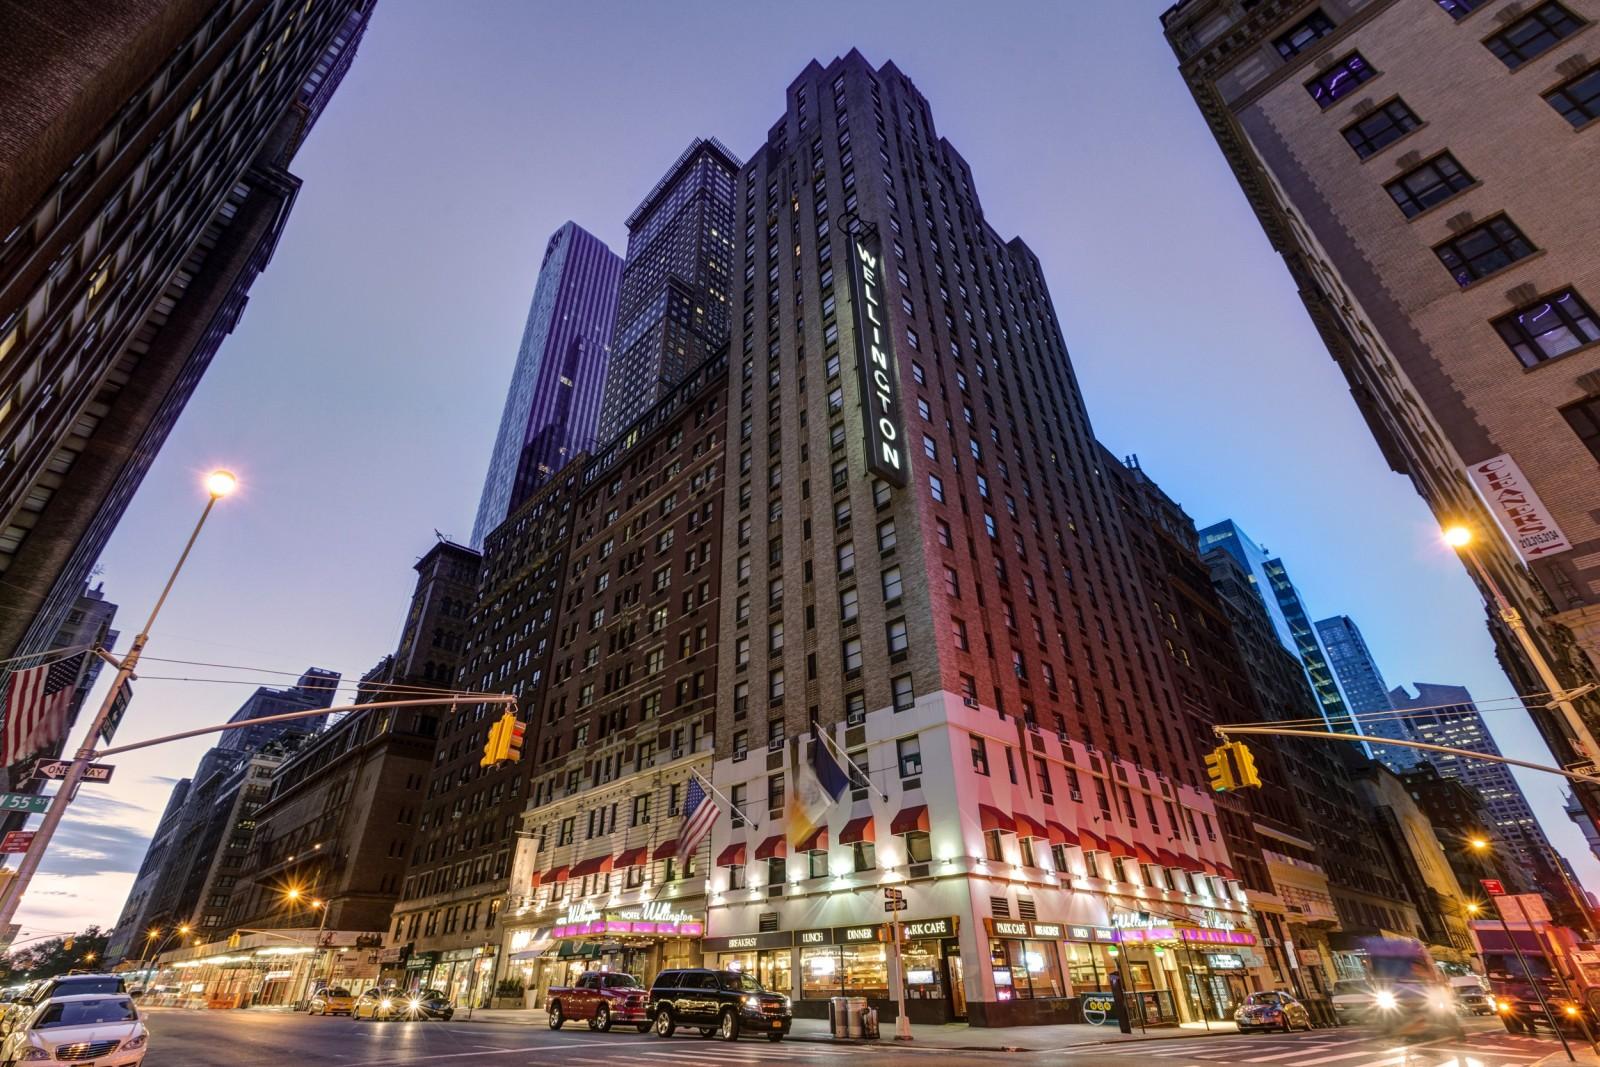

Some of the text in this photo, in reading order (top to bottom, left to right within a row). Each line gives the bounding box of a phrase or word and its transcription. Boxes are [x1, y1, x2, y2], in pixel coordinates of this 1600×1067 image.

[856, 242, 900, 470] WELLINGTON
[48, 765, 69, 775] ONE
[9, 796, 32, 808] 55
[642, 901, 693, 927] Wellington
[924, 920, 946, 934] CAFÉ
[996, 922, 1012, 934] PARK
[802, 932, 823, 942] LUNCH
[847, 928, 872, 940] DINNER
[728, 937, 757, 948] BREAKFAST
